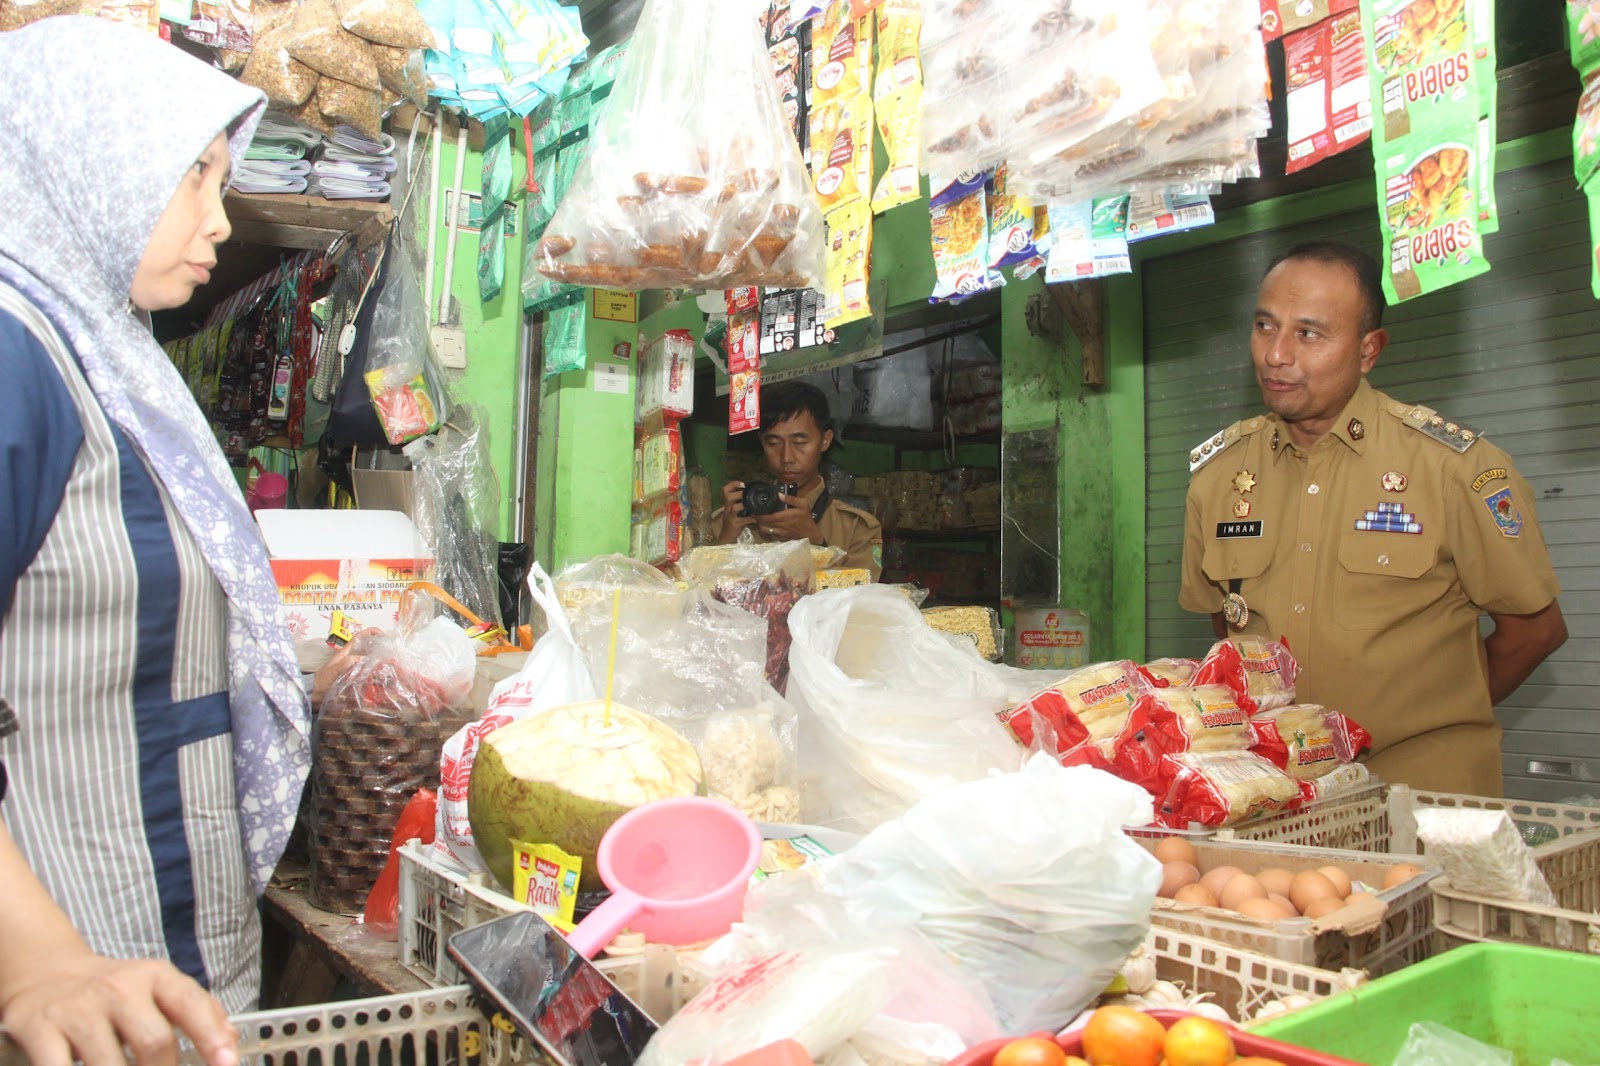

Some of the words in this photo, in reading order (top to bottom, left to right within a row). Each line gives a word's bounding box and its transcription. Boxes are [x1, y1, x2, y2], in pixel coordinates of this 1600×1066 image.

[1405, 52, 1470, 103] selera
[1411, 219, 1473, 265] selera
[760, 373, 783, 384] TOKO
[1223, 524, 1255, 534] IMRAN
[290, 583, 321, 591] KRUPUK
[318, 604, 342, 612] ENAK
[344, 603, 383, 611] RASANYA
[526, 877, 561, 908] Racik
